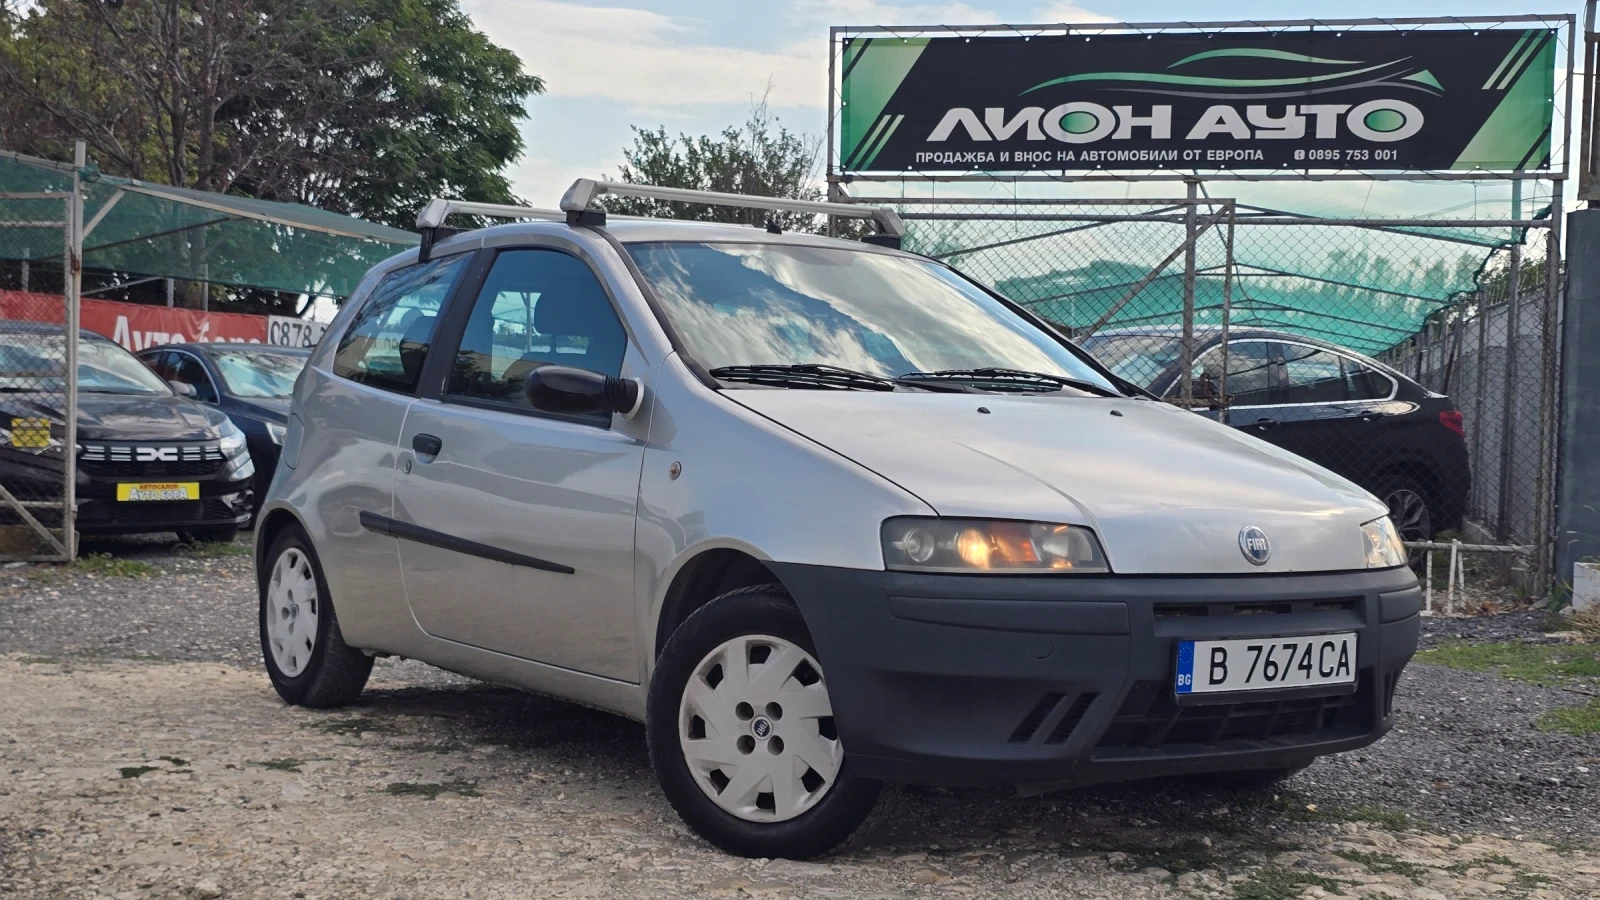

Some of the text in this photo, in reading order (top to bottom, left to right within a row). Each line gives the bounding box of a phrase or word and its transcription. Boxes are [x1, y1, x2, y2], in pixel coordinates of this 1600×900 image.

[926, 98, 1425, 144] ЛИОН АУТО
[915, 149, 1264, 164] ПРОДАЖБА И ВНОС НА АВТОМОБИЛИ ОТ ЕВРОПА
[1308, 149, 1398, 161] 0895 753 001
[271, 321, 312, 348] 0878
[1247, 538, 1267, 551] FIAT
[1177, 674, 1192, 686] BG
